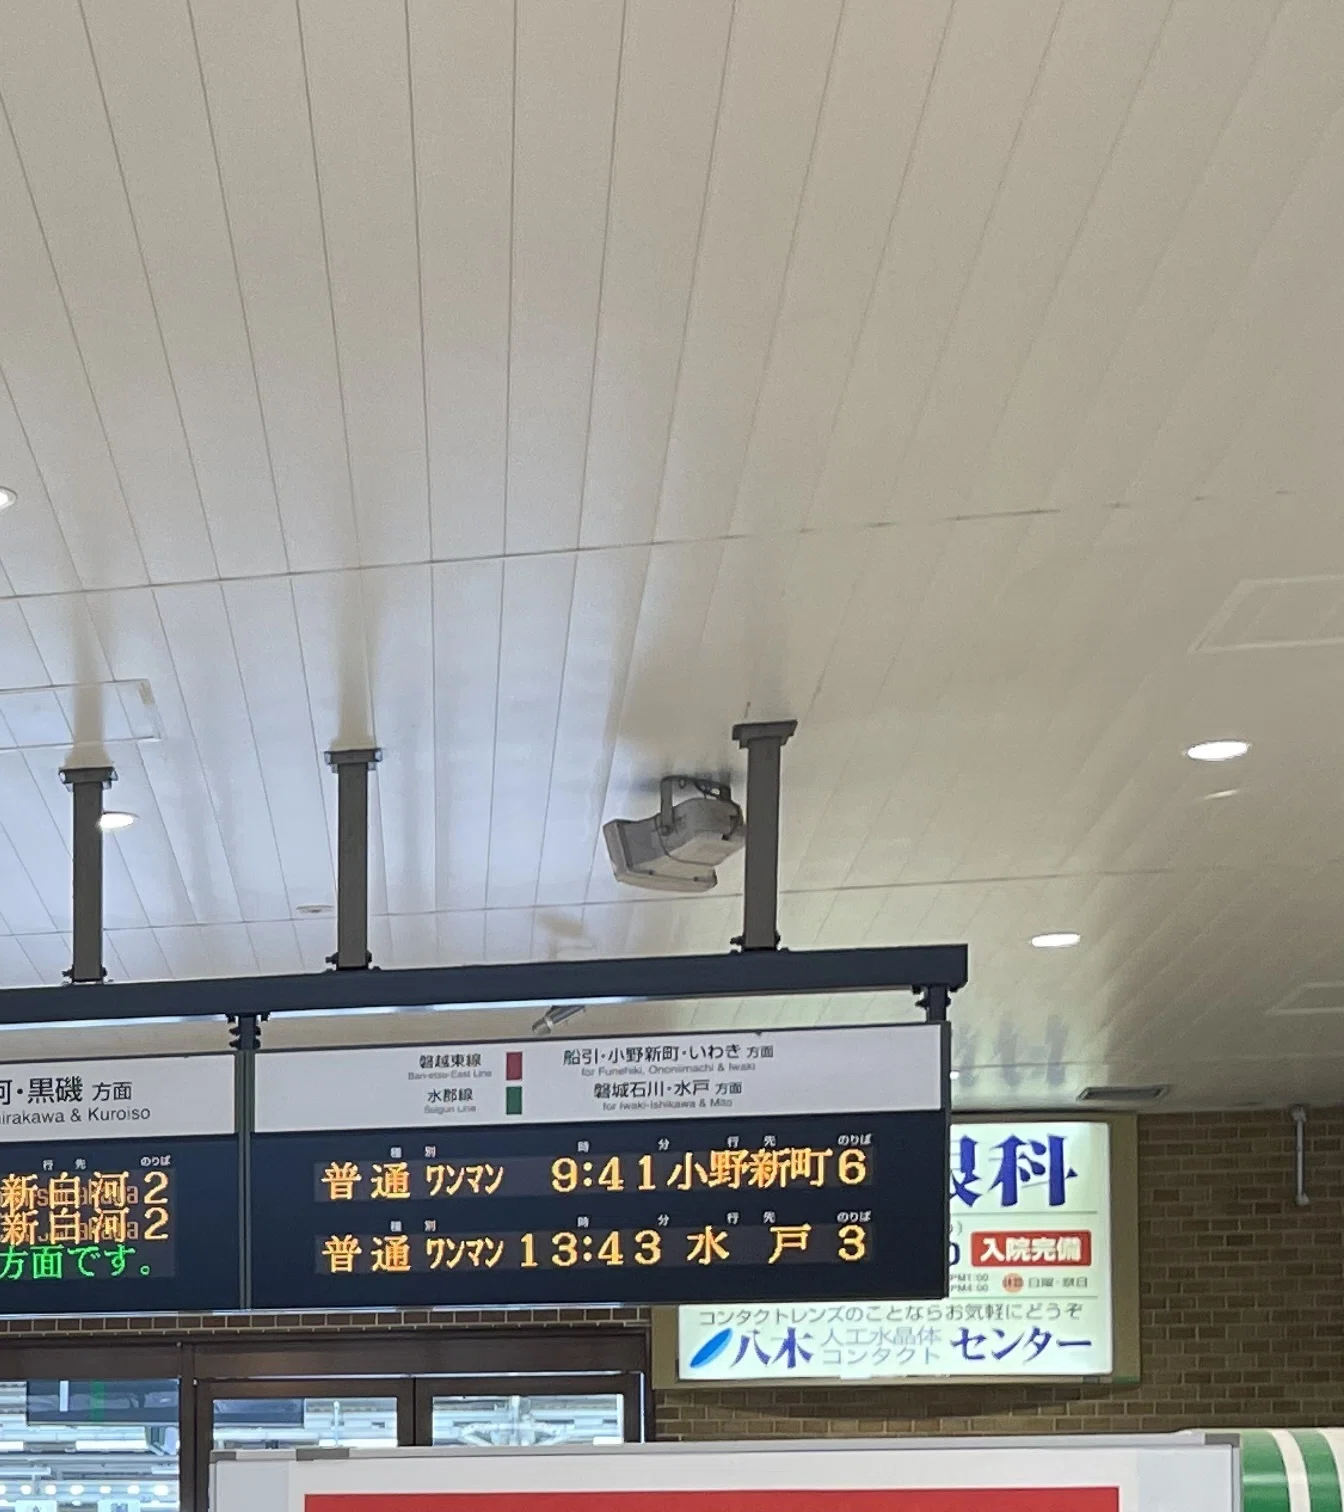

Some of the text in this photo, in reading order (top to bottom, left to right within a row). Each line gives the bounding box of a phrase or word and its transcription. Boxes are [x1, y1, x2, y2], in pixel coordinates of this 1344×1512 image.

[91, 1081, 133, 1103] 方面
[71, 1109, 82, 1124] &
[88, 1106, 151, 1122] Kuroiso
[143, 1171, 169, 1205] 2
[322, 1160, 411, 1200] 普通
[551, 1156, 656, 1192] 9:41
[667, 1148, 831, 1190] 小野新町
[837, 1150, 866, 1186] 6
[143, 1207, 169, 1240] 2
[322, 1234, 411, 1273] 普通
[520, 1229, 662, 1267] 13:43
[837, 1224, 866, 1261] 3
[730, 1327, 814, 1369] 八木
[949, 1325, 1092, 1363] センター
[823, 1348, 941, 1366] コンタクト
